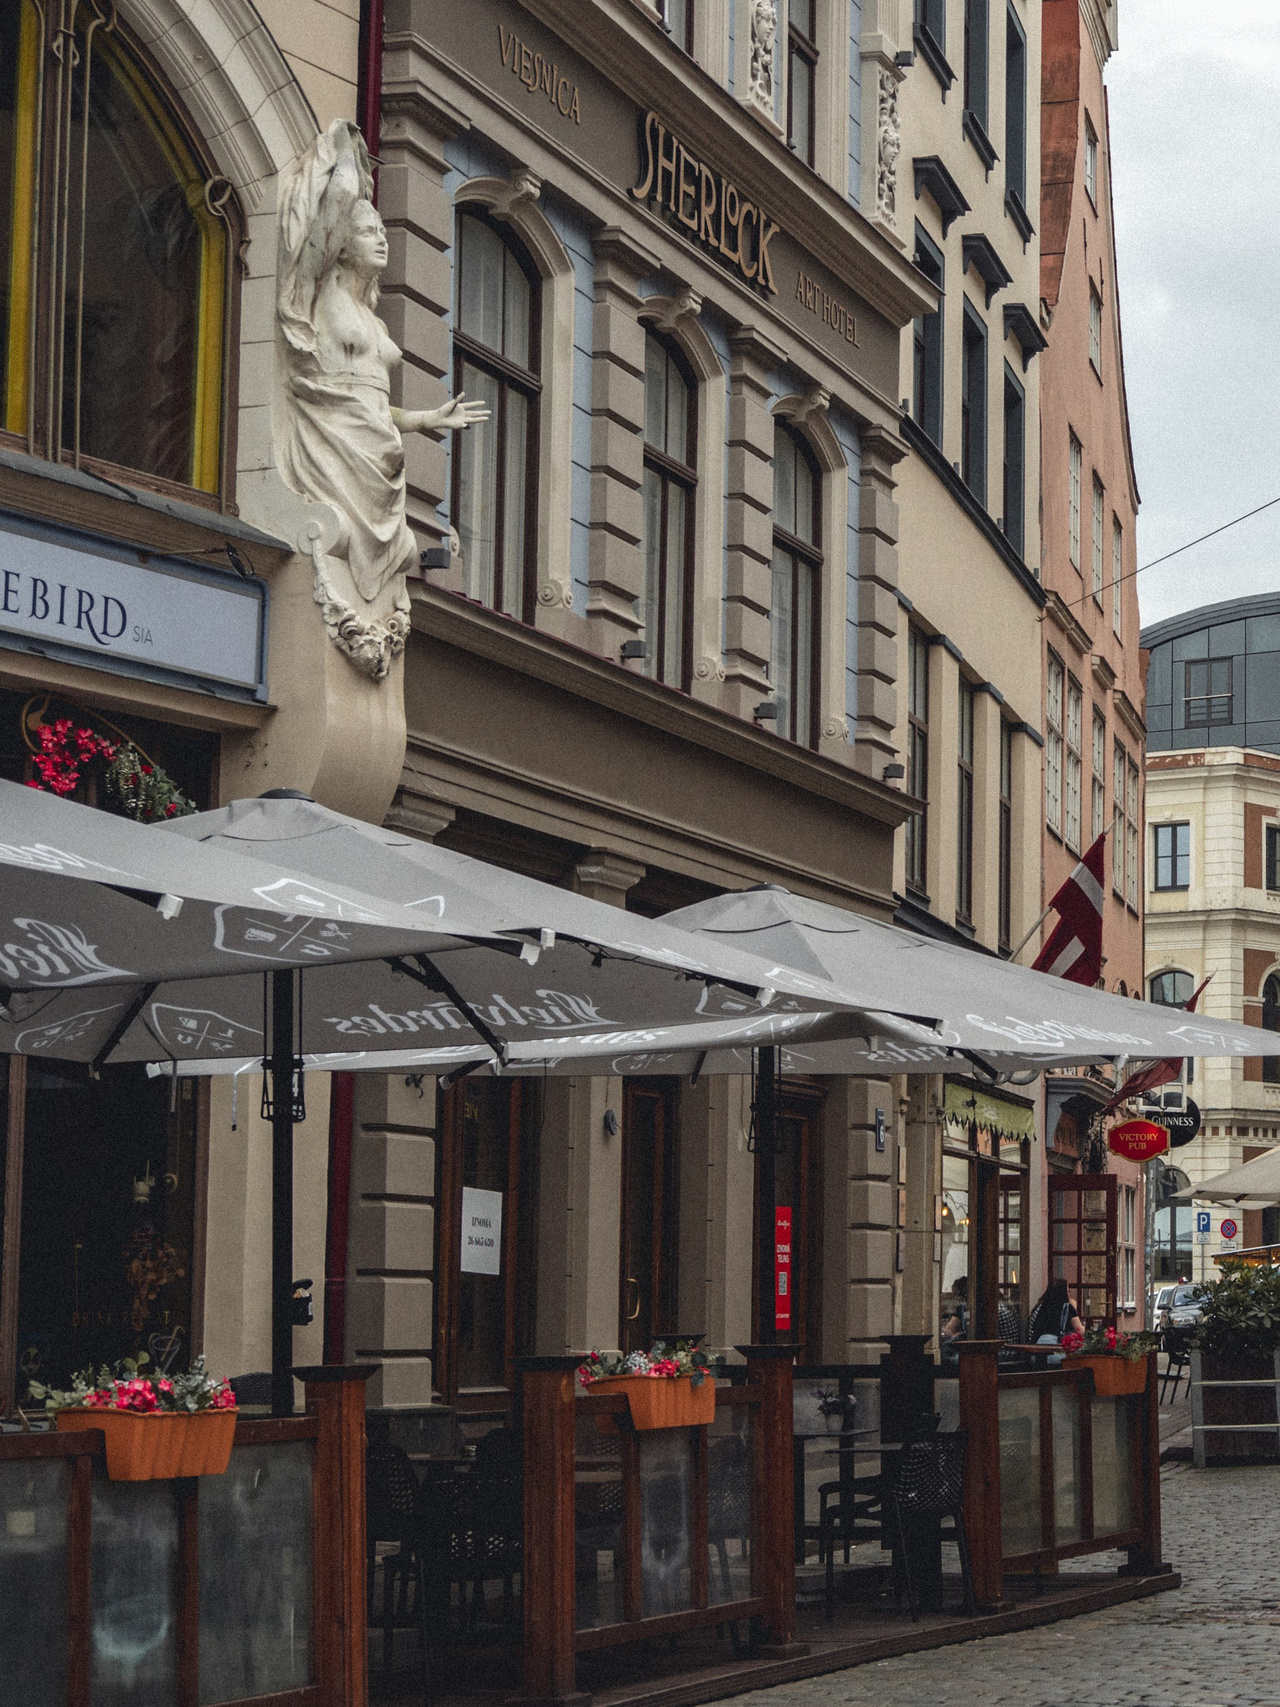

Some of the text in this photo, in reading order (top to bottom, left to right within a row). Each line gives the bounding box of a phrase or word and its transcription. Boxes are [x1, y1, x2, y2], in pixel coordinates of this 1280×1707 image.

[795, 271, 861, 349] ART HOTEL
[1, 569, 154, 646] EBIRD SIA
[1151, 1115, 1194, 1127] GUINNESS
[1118, 1133, 1159, 1141] VICTORY
[1128, 1142, 1147, 1150] PUB
[1201, 1214, 1208, 1230] P
